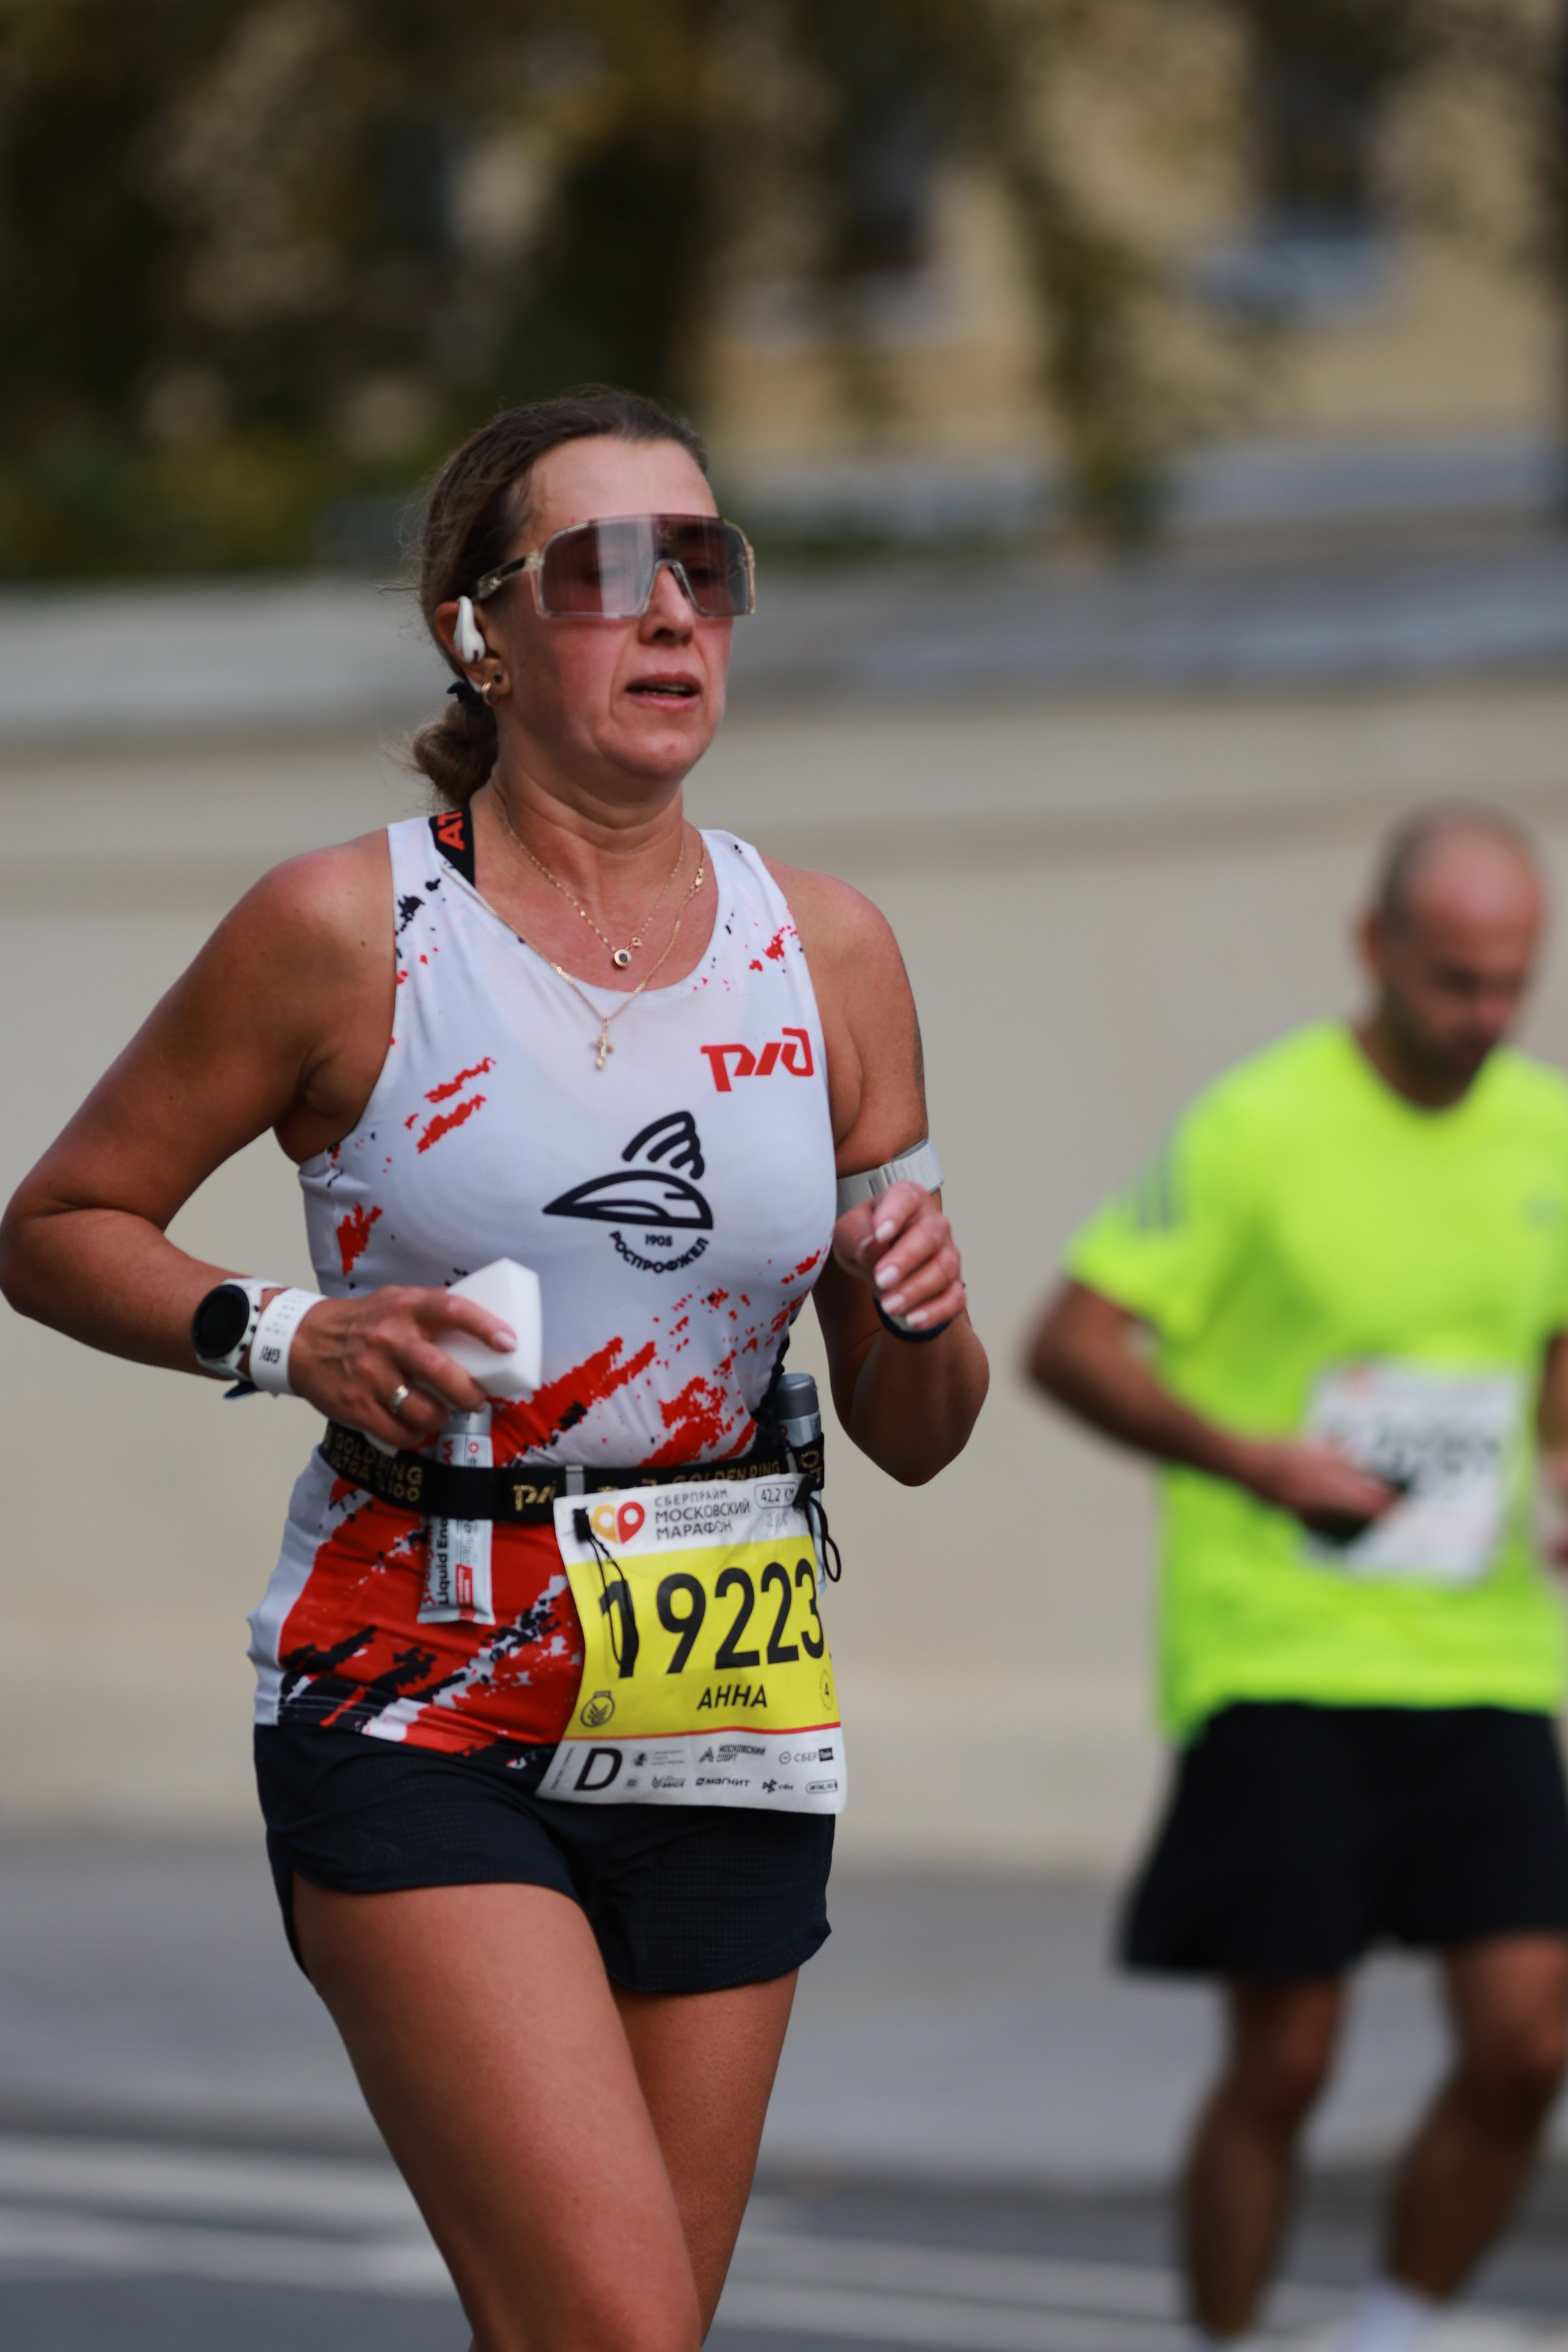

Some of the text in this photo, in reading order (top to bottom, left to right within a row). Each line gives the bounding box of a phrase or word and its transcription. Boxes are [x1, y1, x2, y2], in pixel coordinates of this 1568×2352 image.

[645, 1233, 673, 1246] 1905
[609, 1231, 710, 1273] РОСПРОФЖЕЛ
[654, 1487, 729, 1507] СБЕРПРАЙМ
[761, 1488, 780, 1503] 42,2
[655, 1498, 750, 1524] МОСКОВСКИЙ
[656, 1520, 733, 1540] МАРАФОН
[436, 1519, 450, 1605] Liquid Ene
[598, 1558, 824, 1679] 19223
[696, 1684, 767, 1711] АННА
[716, 1754, 737, 1763] СПОРТ
[718, 1744, 766, 1756] МОСКОВСКИЙ
[794, 1751, 817, 1762] СБЕР
[573, 1747, 623, 1791] D
